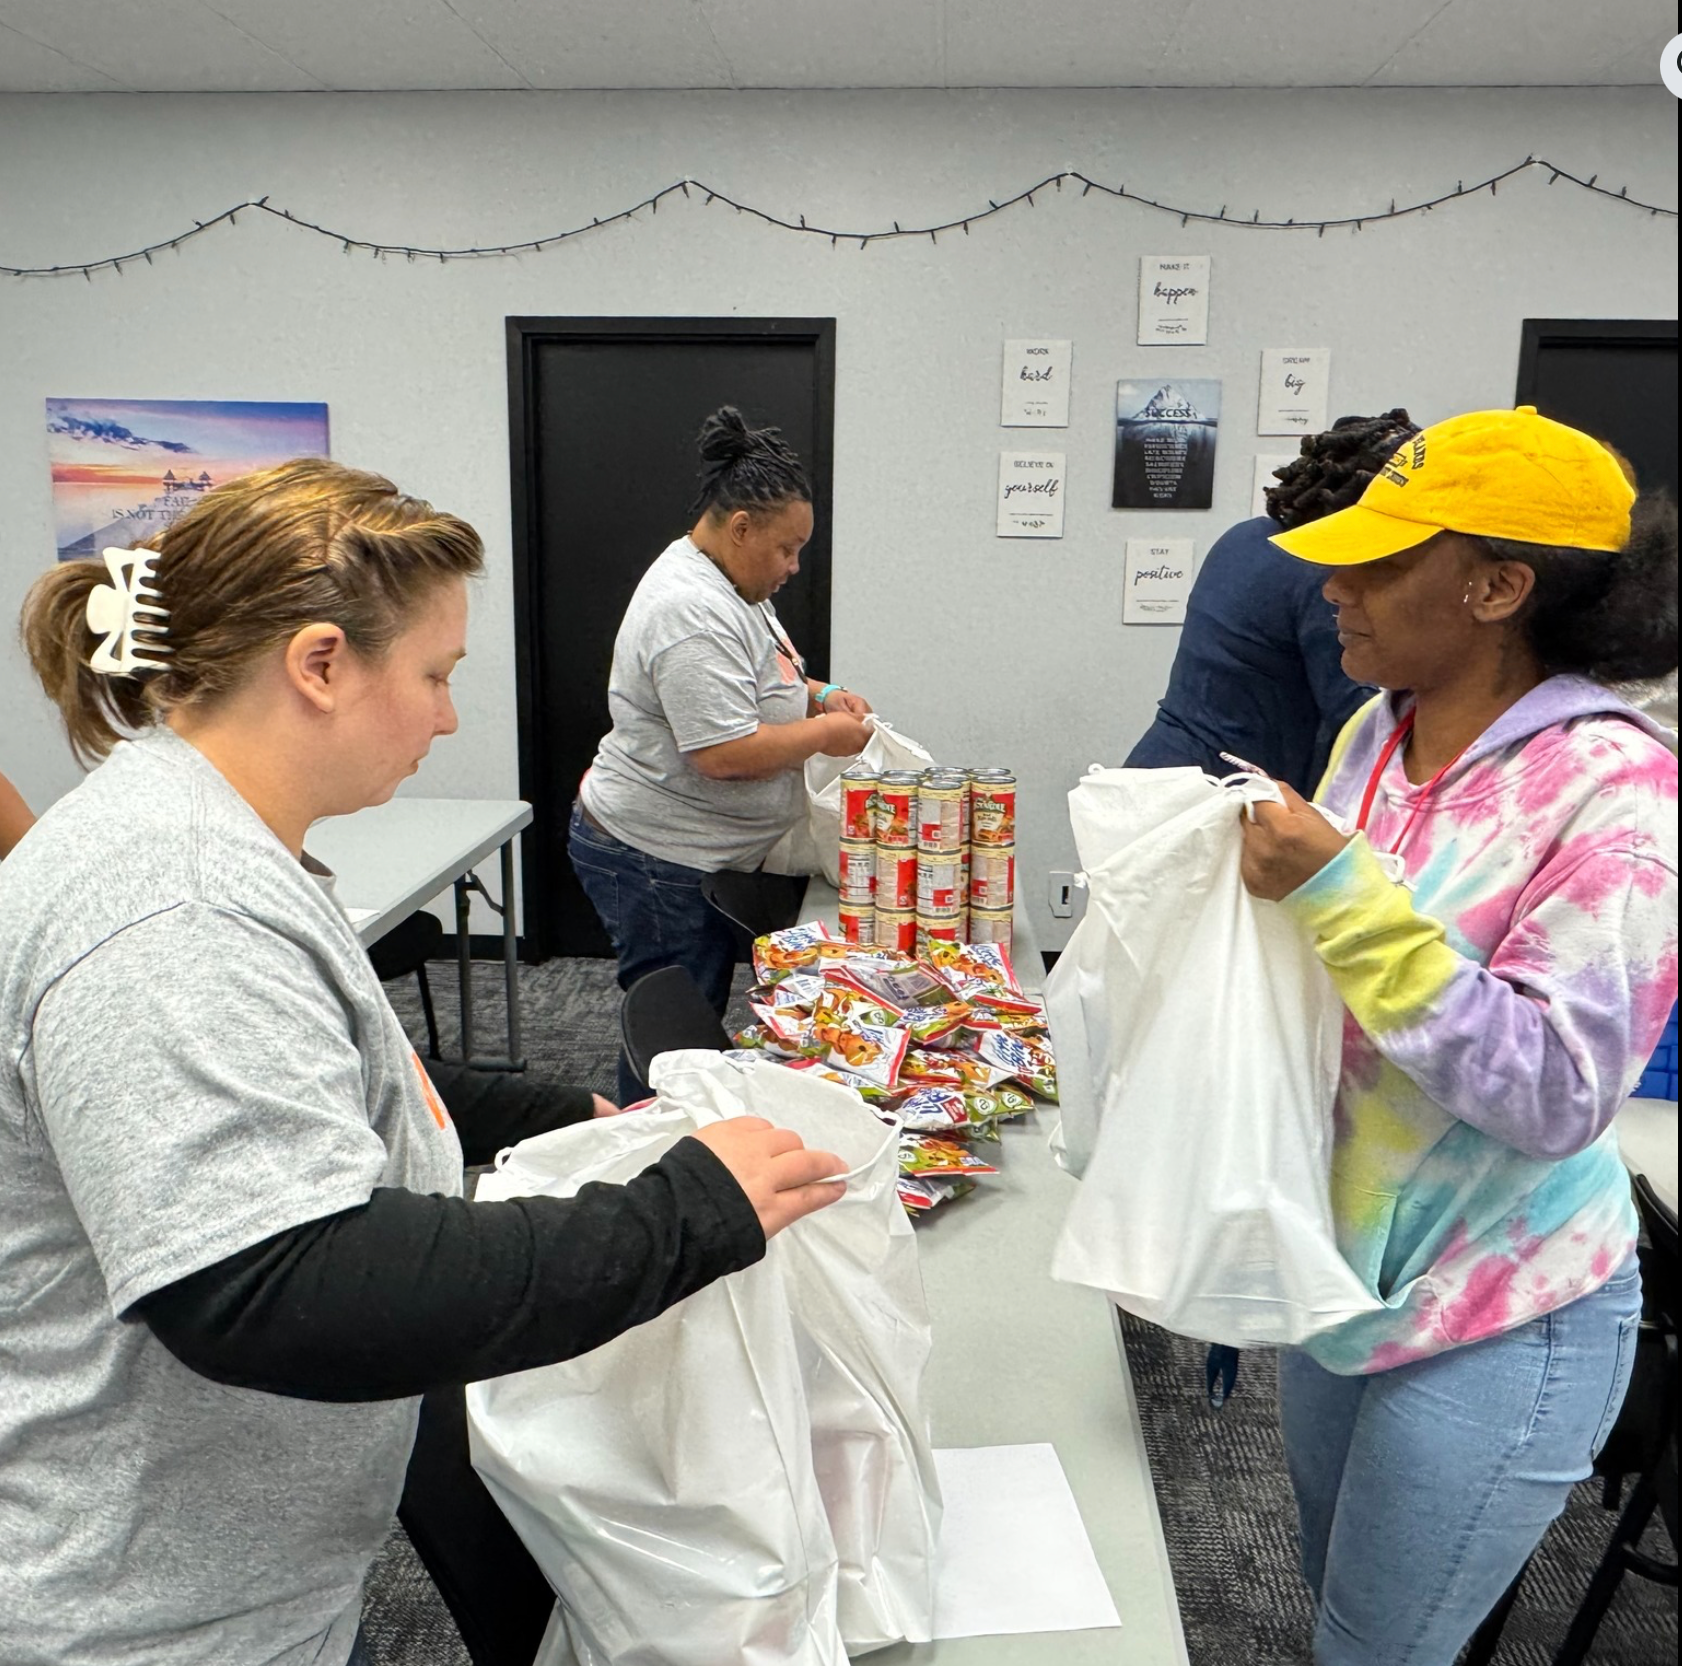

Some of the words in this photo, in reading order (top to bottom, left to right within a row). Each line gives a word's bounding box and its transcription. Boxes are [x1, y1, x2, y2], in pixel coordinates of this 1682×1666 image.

[1153, 281, 1198, 305] happen
[1020, 365, 1053, 381] hard
[1284, 373, 1306, 396] big
[1145, 408, 1191, 418] SUCCESS
[1004, 479, 1059, 499] yourself
[126, 509, 154, 520] NOT
[1150, 547, 1169, 555] STAY
[1134, 564, 1183, 586] positive
